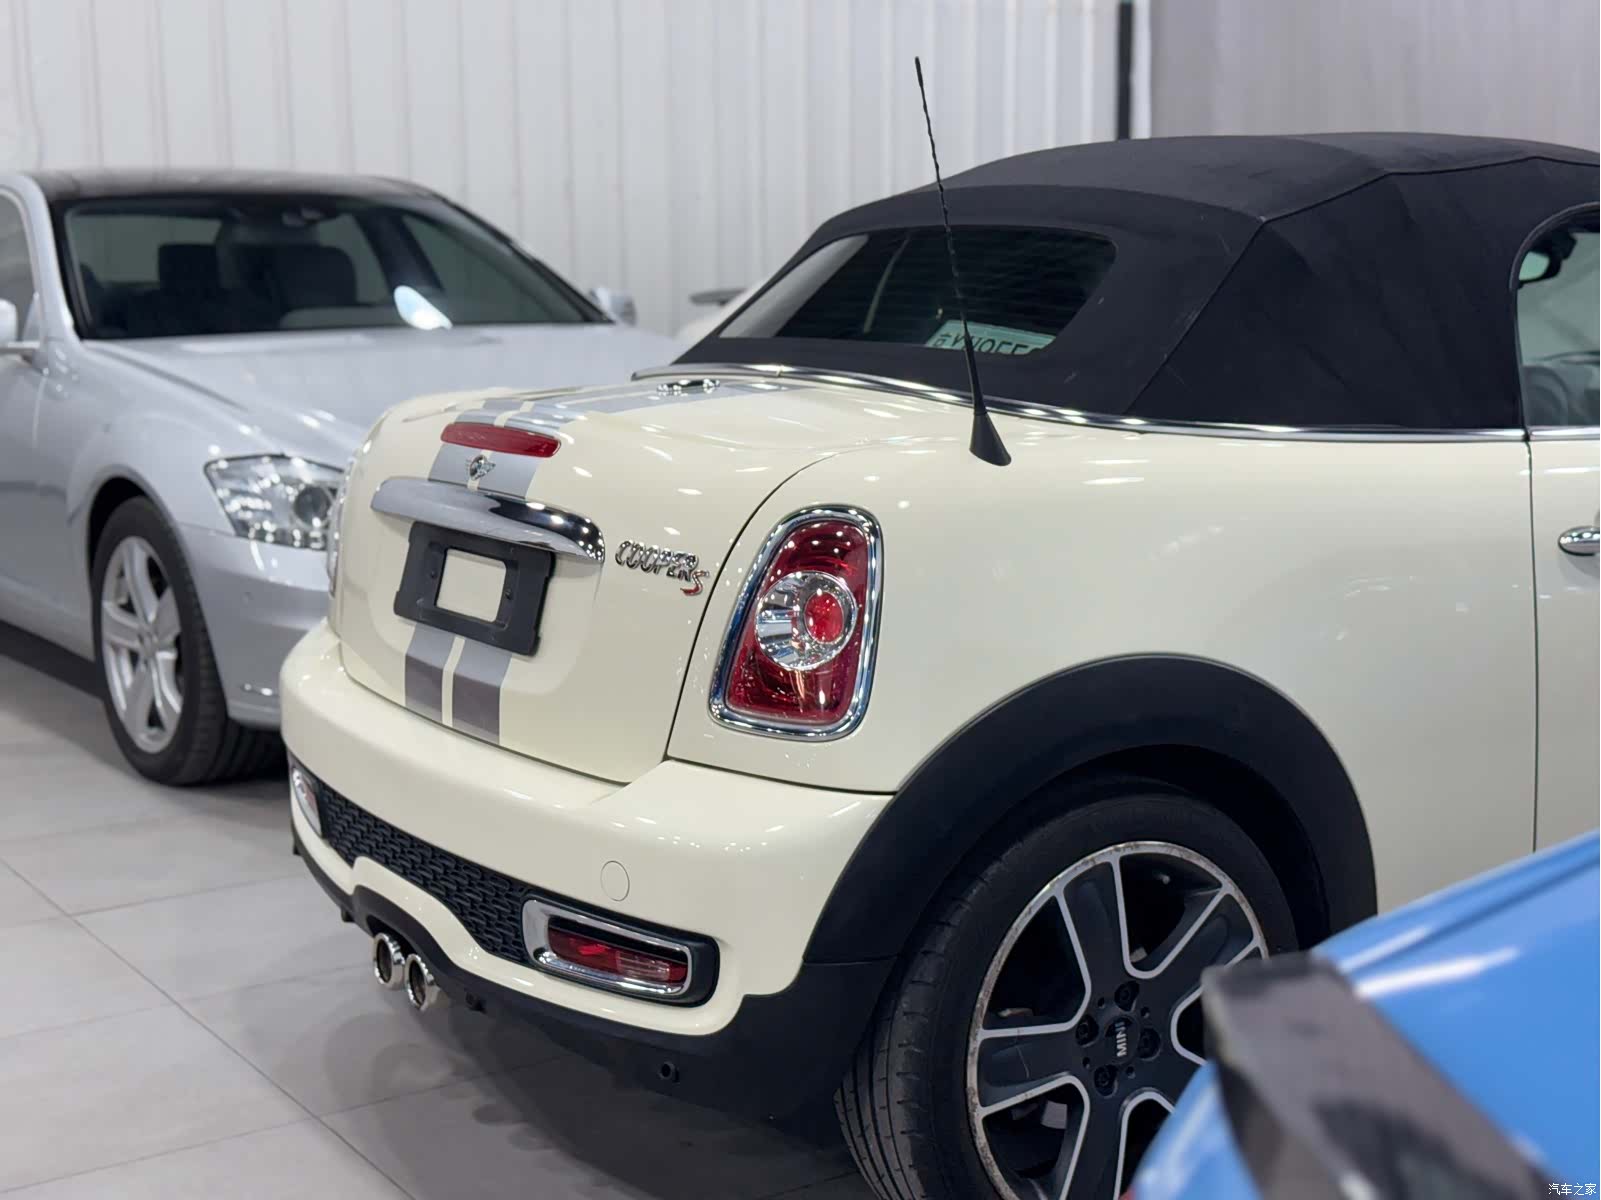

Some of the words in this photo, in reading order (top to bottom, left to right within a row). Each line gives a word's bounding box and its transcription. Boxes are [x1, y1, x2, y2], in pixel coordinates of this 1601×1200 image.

[615, 540, 699, 582] COOPER
[680, 569, 710, 596] S
[1115, 1021, 1127, 1057] MINI
